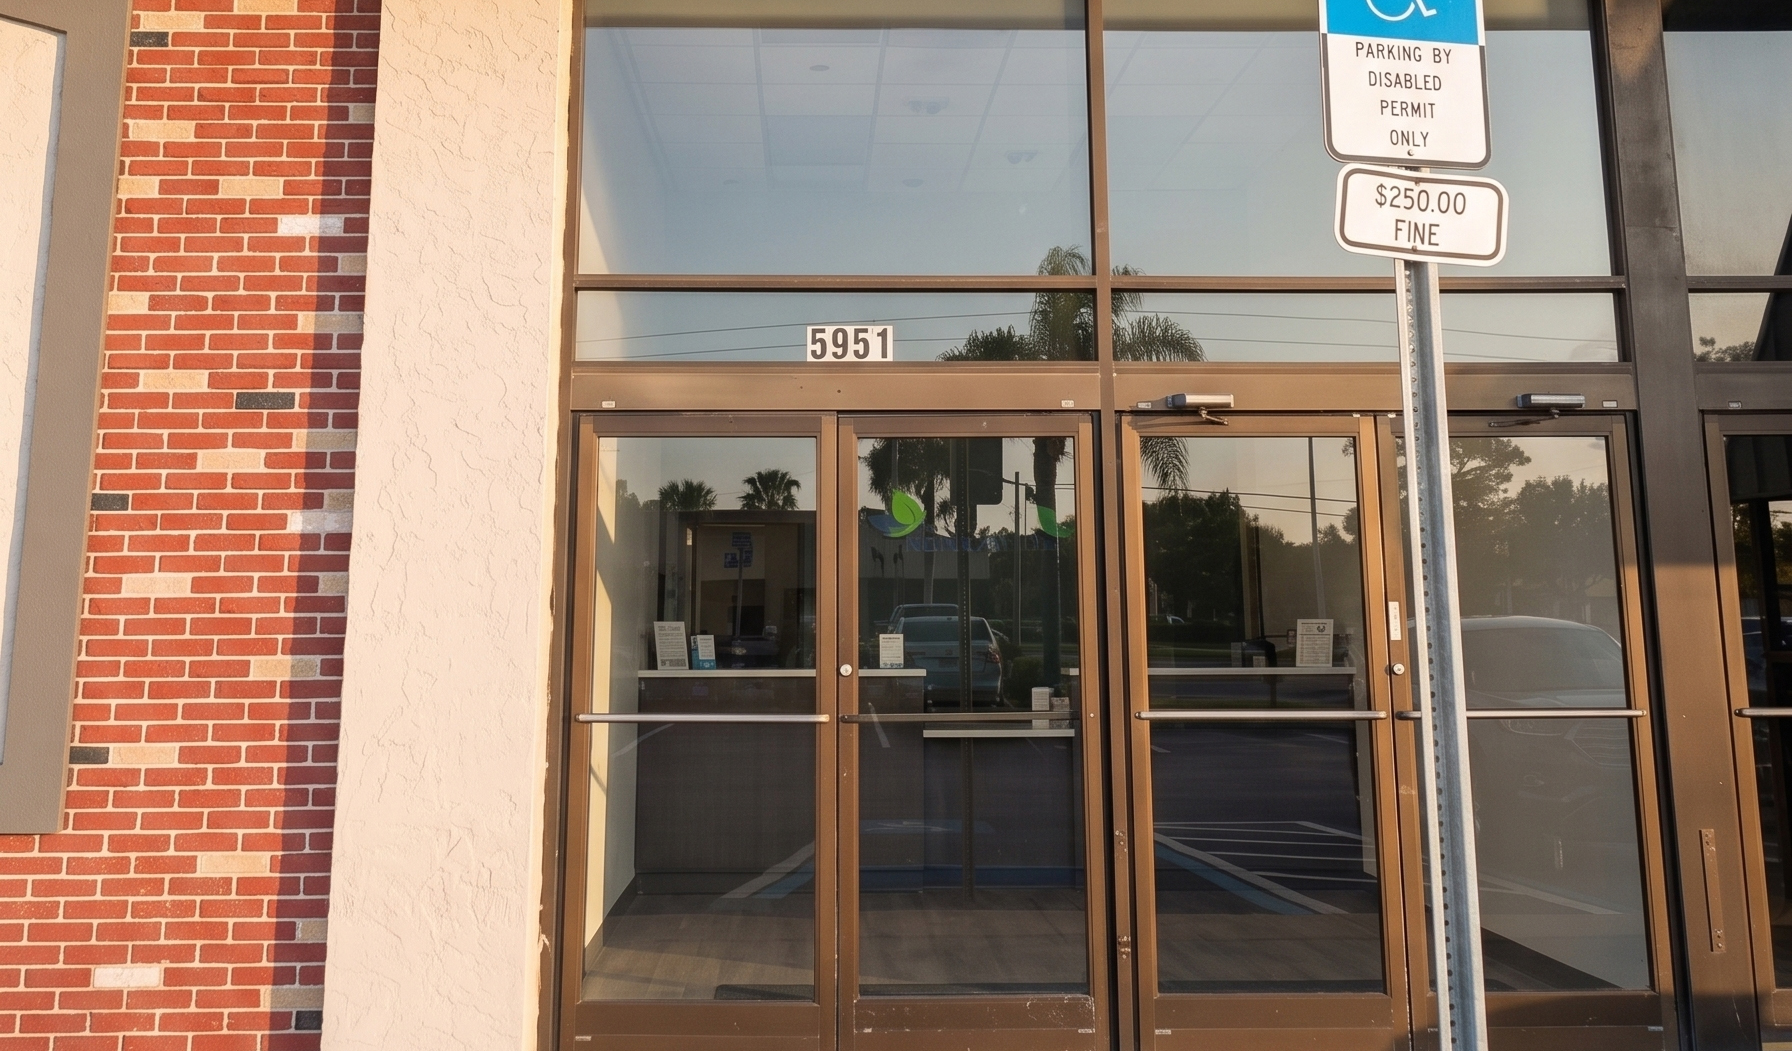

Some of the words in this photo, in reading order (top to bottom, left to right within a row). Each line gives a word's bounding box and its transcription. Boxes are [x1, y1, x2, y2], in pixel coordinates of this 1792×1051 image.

[1355, 41, 1422, 63] PARKING
[1433, 48, 1452, 65] BY
[1368, 70, 1442, 91] DISABLED
[1380, 99, 1436, 119] PERMIT
[1389, 129, 1429, 148] ONLY
[1375, 183, 1467, 216] $250.00
[1394, 218, 1440, 247] FINE
[810, 327, 888, 360] 5951
